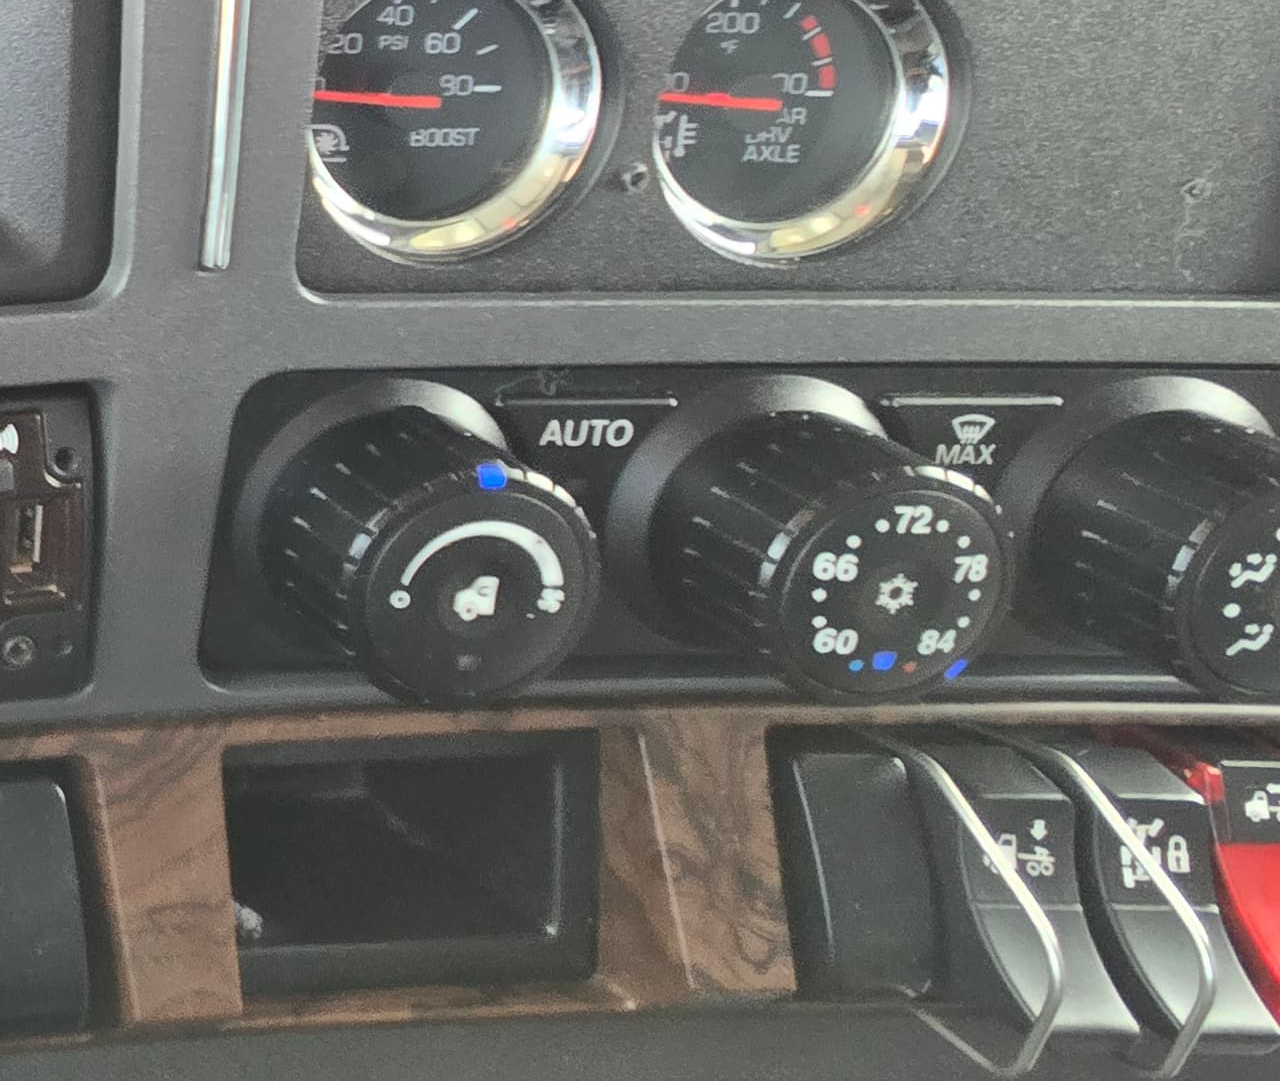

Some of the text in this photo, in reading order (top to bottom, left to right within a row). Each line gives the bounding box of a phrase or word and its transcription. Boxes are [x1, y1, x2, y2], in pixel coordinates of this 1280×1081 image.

[376, 5, 415, 27] 40
[705, 12, 761, 35] 200
[327, 32, 364, 55] 20
[378, 35, 410, 51] PSI
[424, 32, 462, 55] 60
[408, 127, 481, 148] BOOST
[742, 144, 801, 164] AXLE
[539, 418, 635, 448] AUTO
[934, 443, 997, 466] MAX
[893, 506, 934, 535] 72
[812, 552, 859, 582] 66
[955, 554, 989, 583] 78
[812, 628, 859, 655] 60
[917, 628, 957, 656] 84
